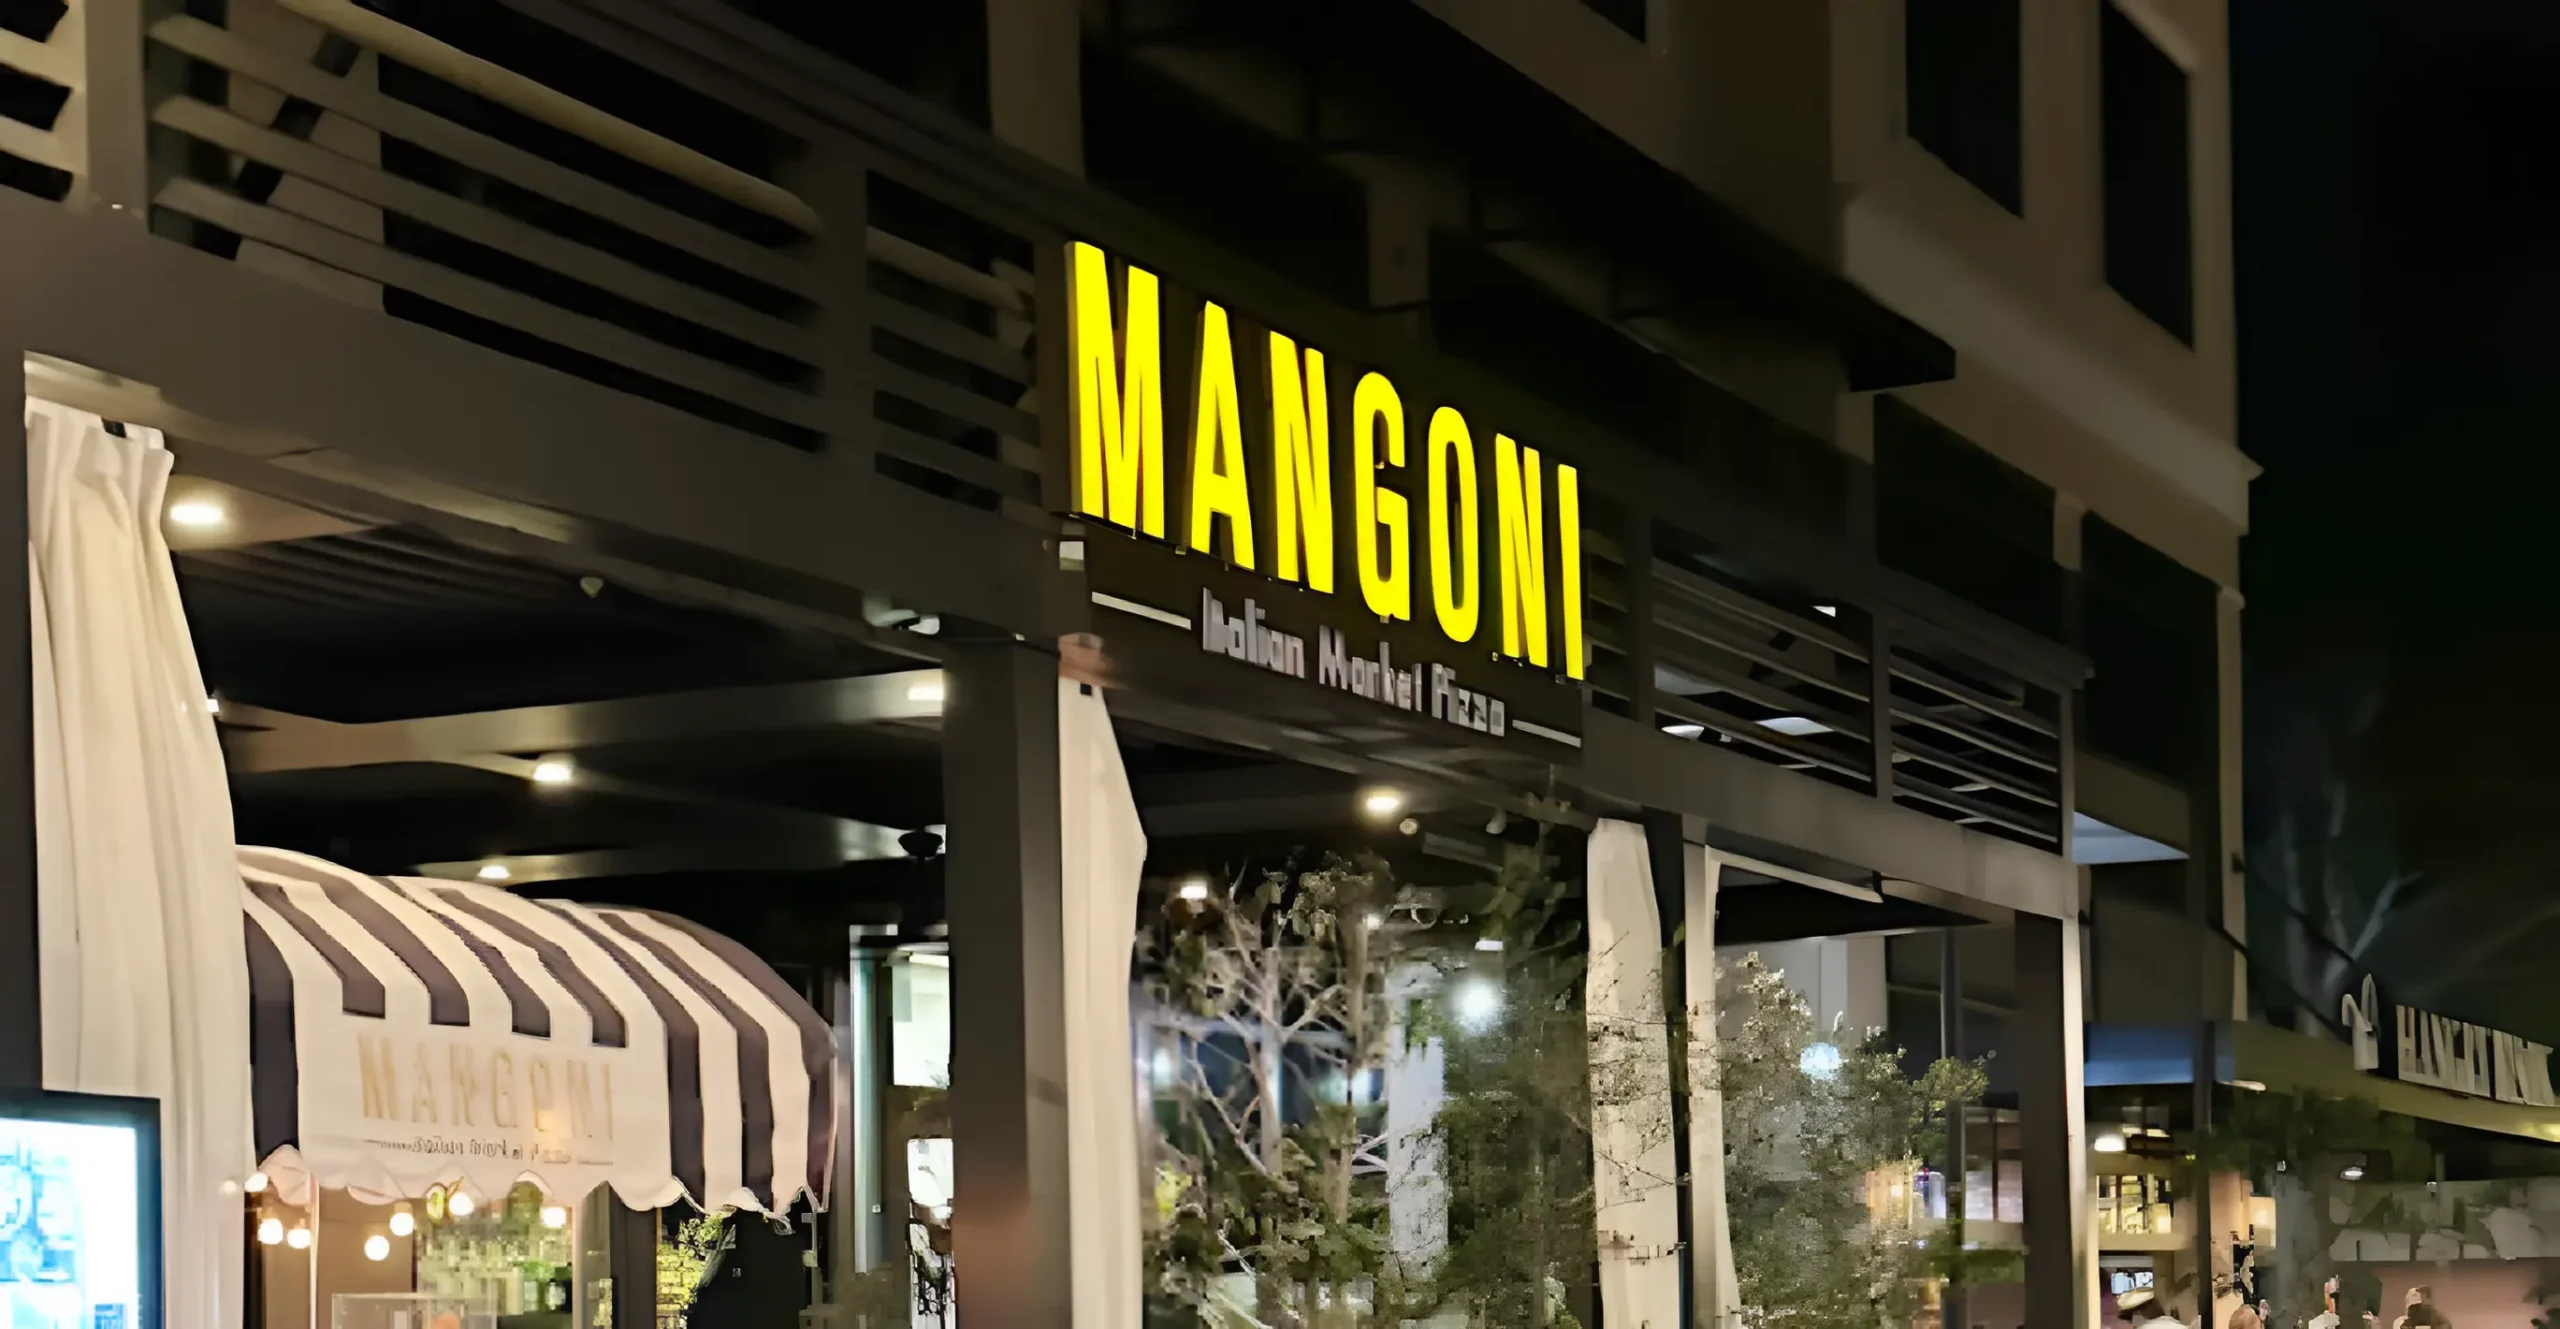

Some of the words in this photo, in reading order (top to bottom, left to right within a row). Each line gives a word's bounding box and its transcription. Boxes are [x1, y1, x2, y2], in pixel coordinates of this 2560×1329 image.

[1067, 241, 1584, 681] MANGONI
[1318, 624, 1423, 712] Market
[357, 1033, 614, 1141] MANGONI
